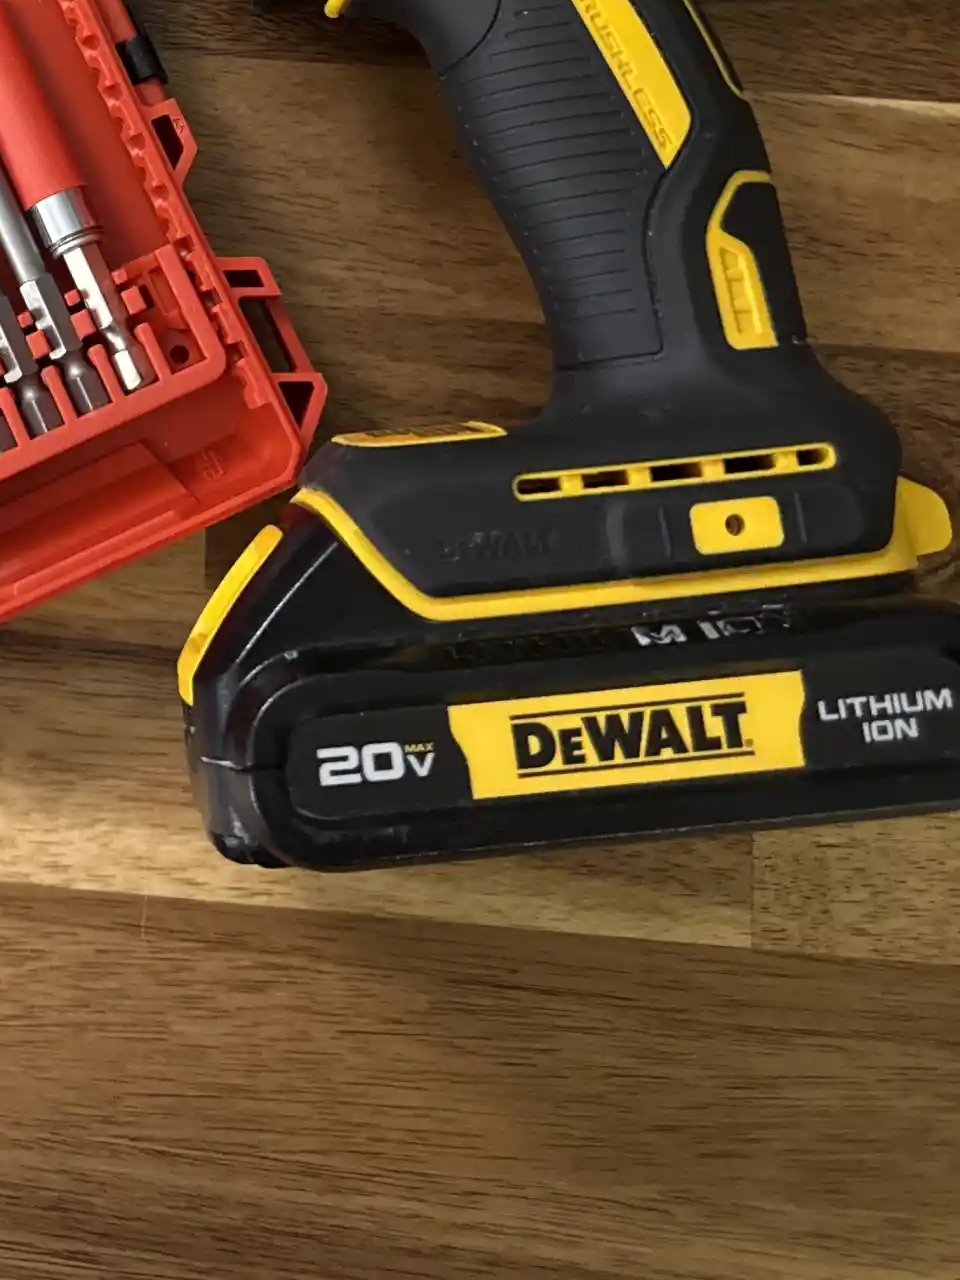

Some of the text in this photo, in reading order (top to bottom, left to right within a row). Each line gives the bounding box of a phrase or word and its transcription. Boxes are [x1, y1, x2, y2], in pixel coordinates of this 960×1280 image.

[817, 687, 953, 721] LITHIUM
[862, 717, 919, 743] ION
[404, 742, 434, 752] MAX
